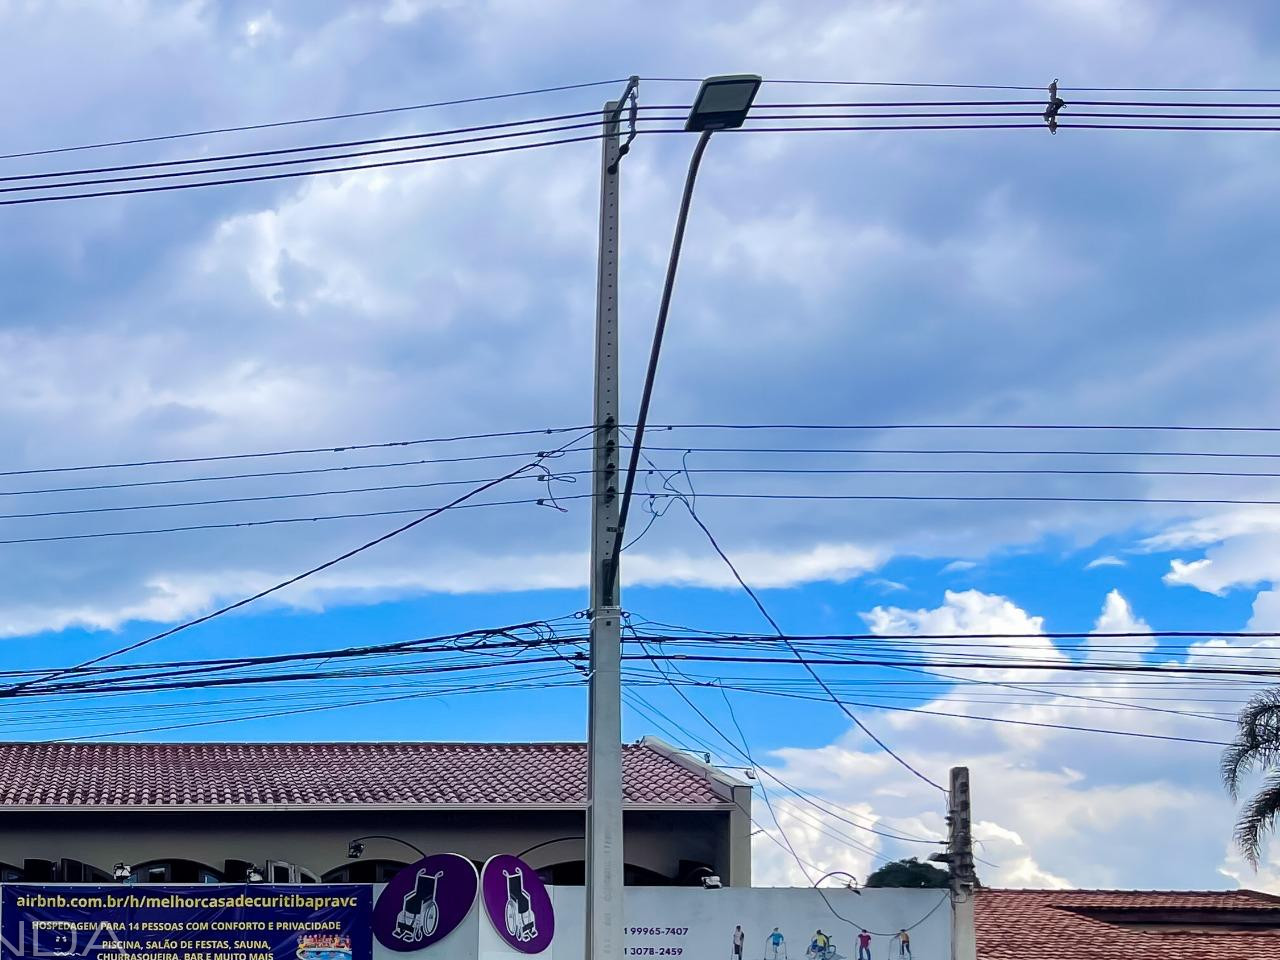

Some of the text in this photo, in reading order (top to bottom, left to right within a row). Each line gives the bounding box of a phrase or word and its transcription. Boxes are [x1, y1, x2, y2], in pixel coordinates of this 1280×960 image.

[16, 894, 357, 910] airbnb.com.br/h/melhorcasadecuritibapravc
[32, 921, 341, 931] HOSPEDAGEM PARA 14 PESSOAS COM CONFORTO E PRIVACIDADE
[630, 927, 689, 936] 99965-7407
[102, 938, 271, 950] PISCINA, SALÃO DE FESTAS, SAUNA,
[630, 947, 683, 956] 3078-2459
